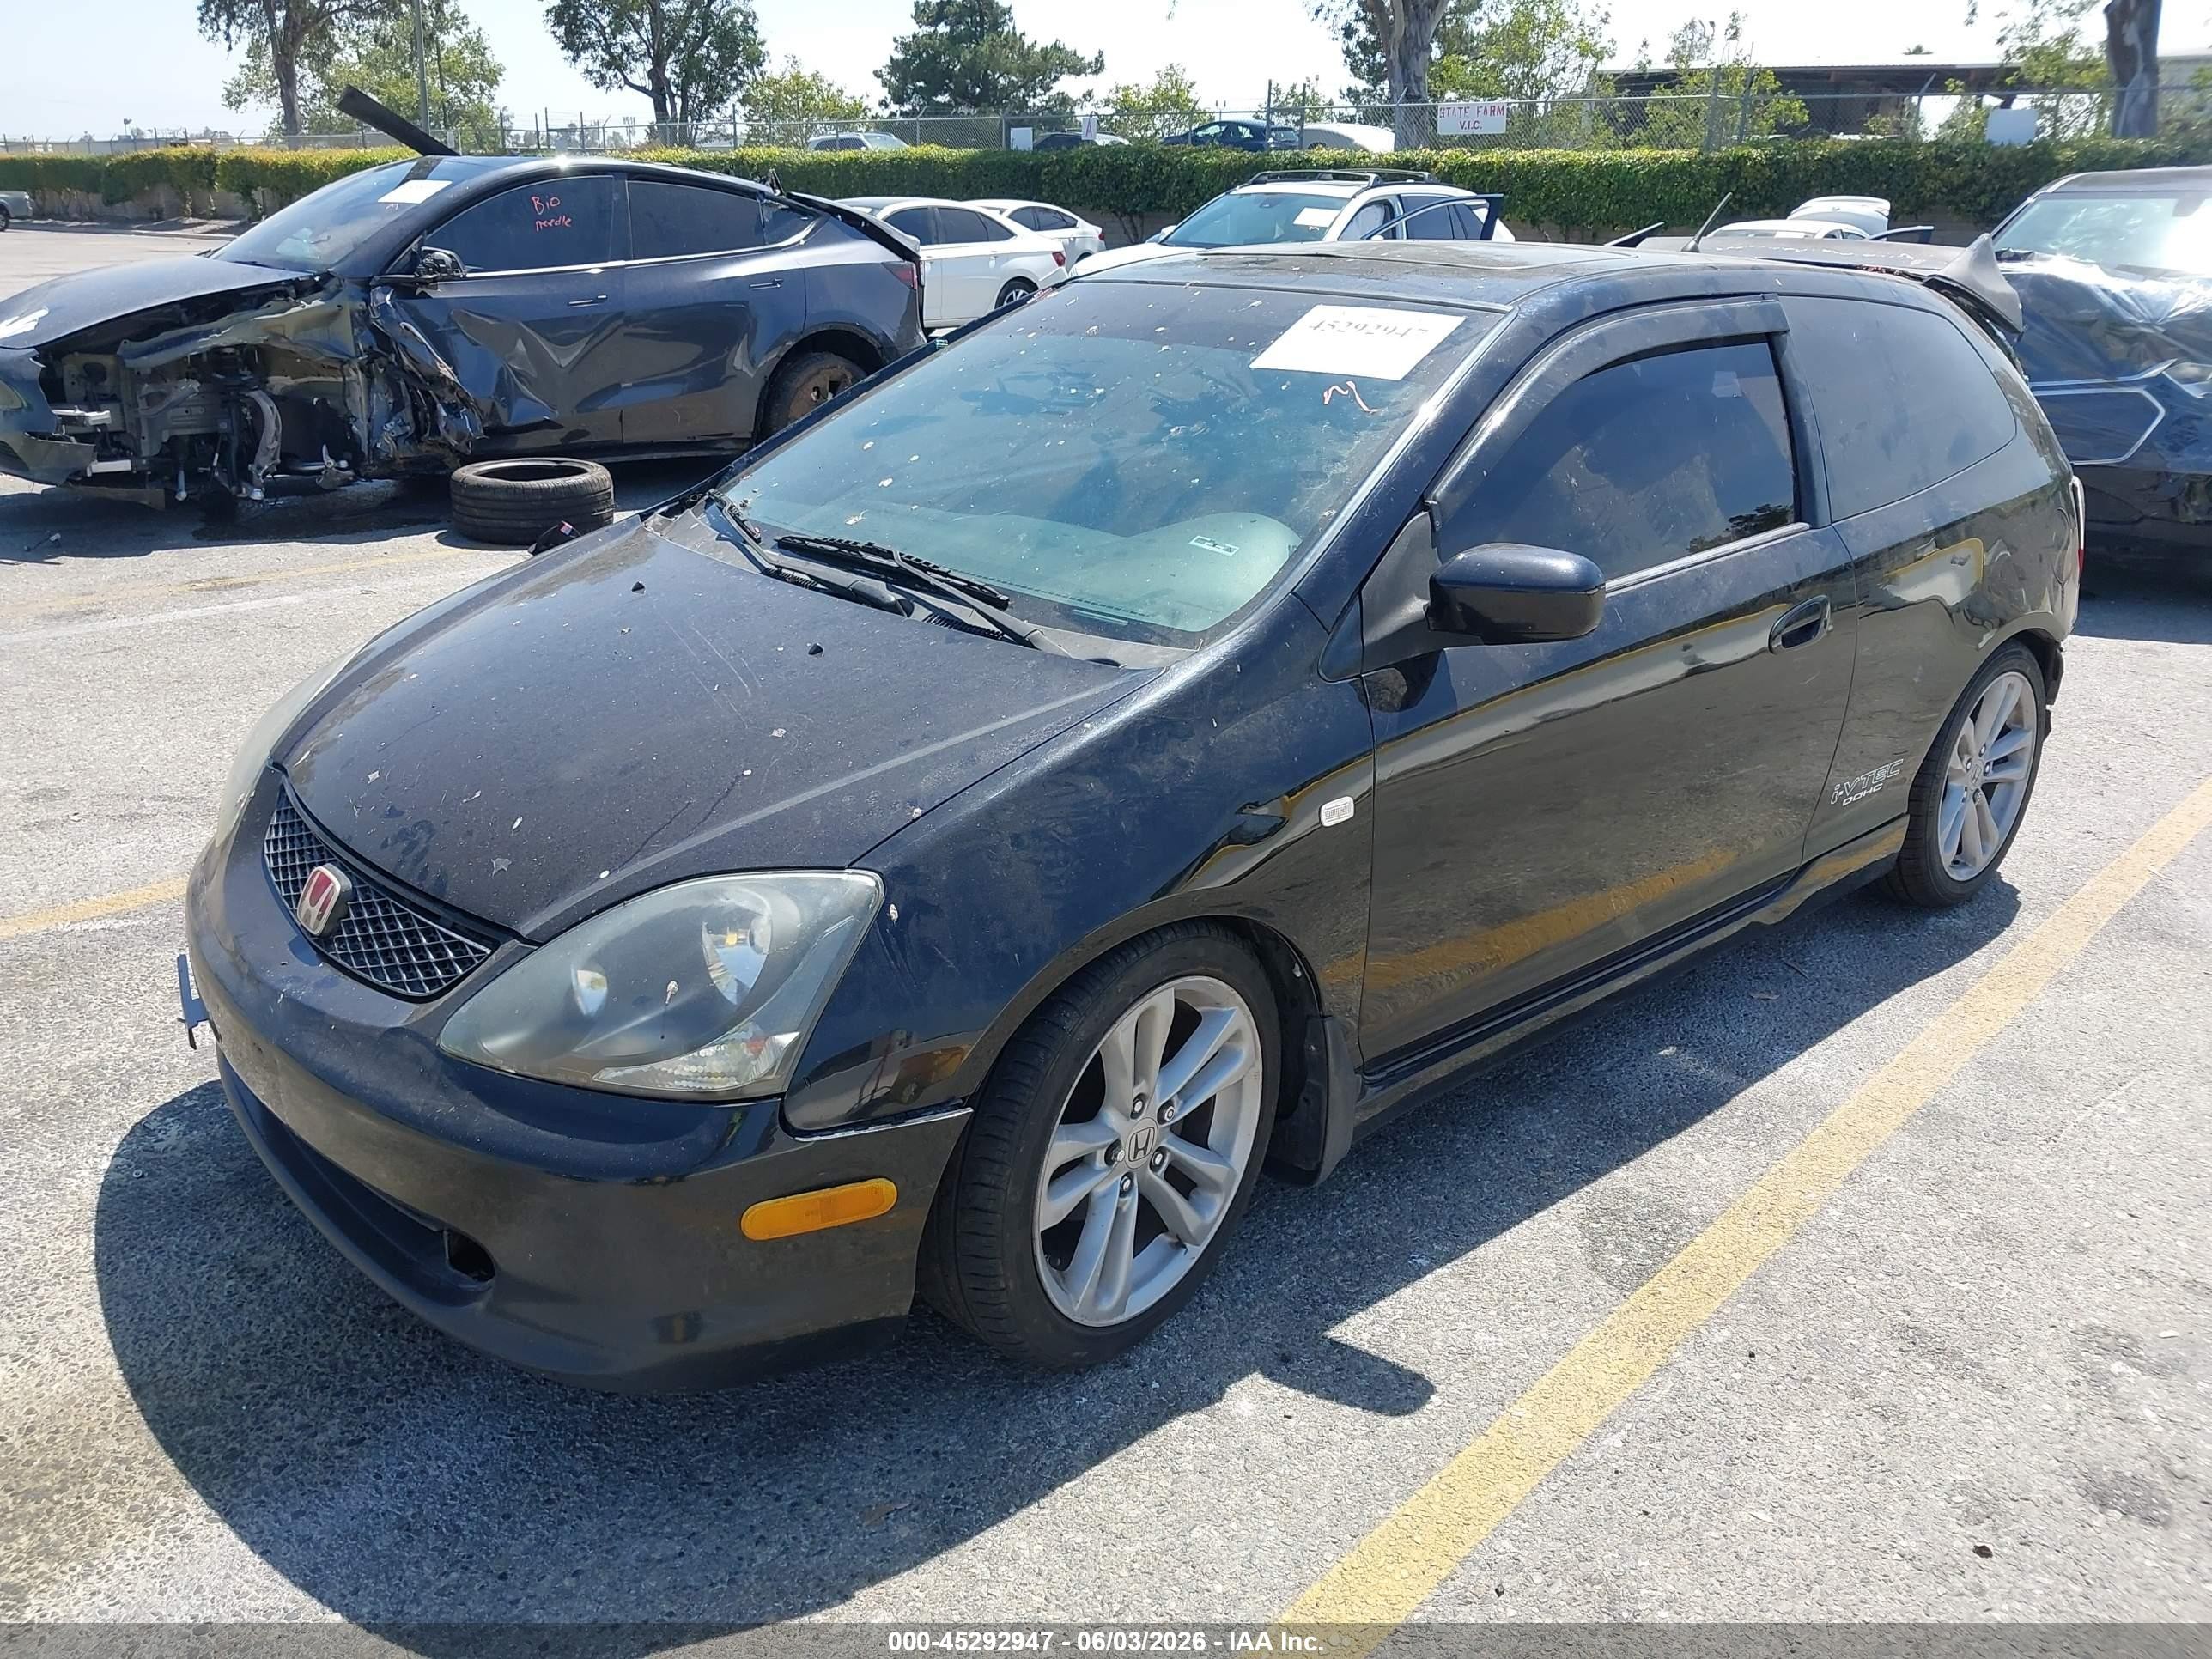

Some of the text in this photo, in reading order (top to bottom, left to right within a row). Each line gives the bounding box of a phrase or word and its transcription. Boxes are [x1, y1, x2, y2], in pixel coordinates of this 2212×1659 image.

[1439, 105, 1504, 118] STATE FARM
[1085, 118, 1092, 137] A
[1459, 120, 1483, 130] V.I.C.
[535, 215, 572, 232] needle
[1830, 758, 1904, 805] i-VTEC
[1842, 783, 1884, 806] DOHC
